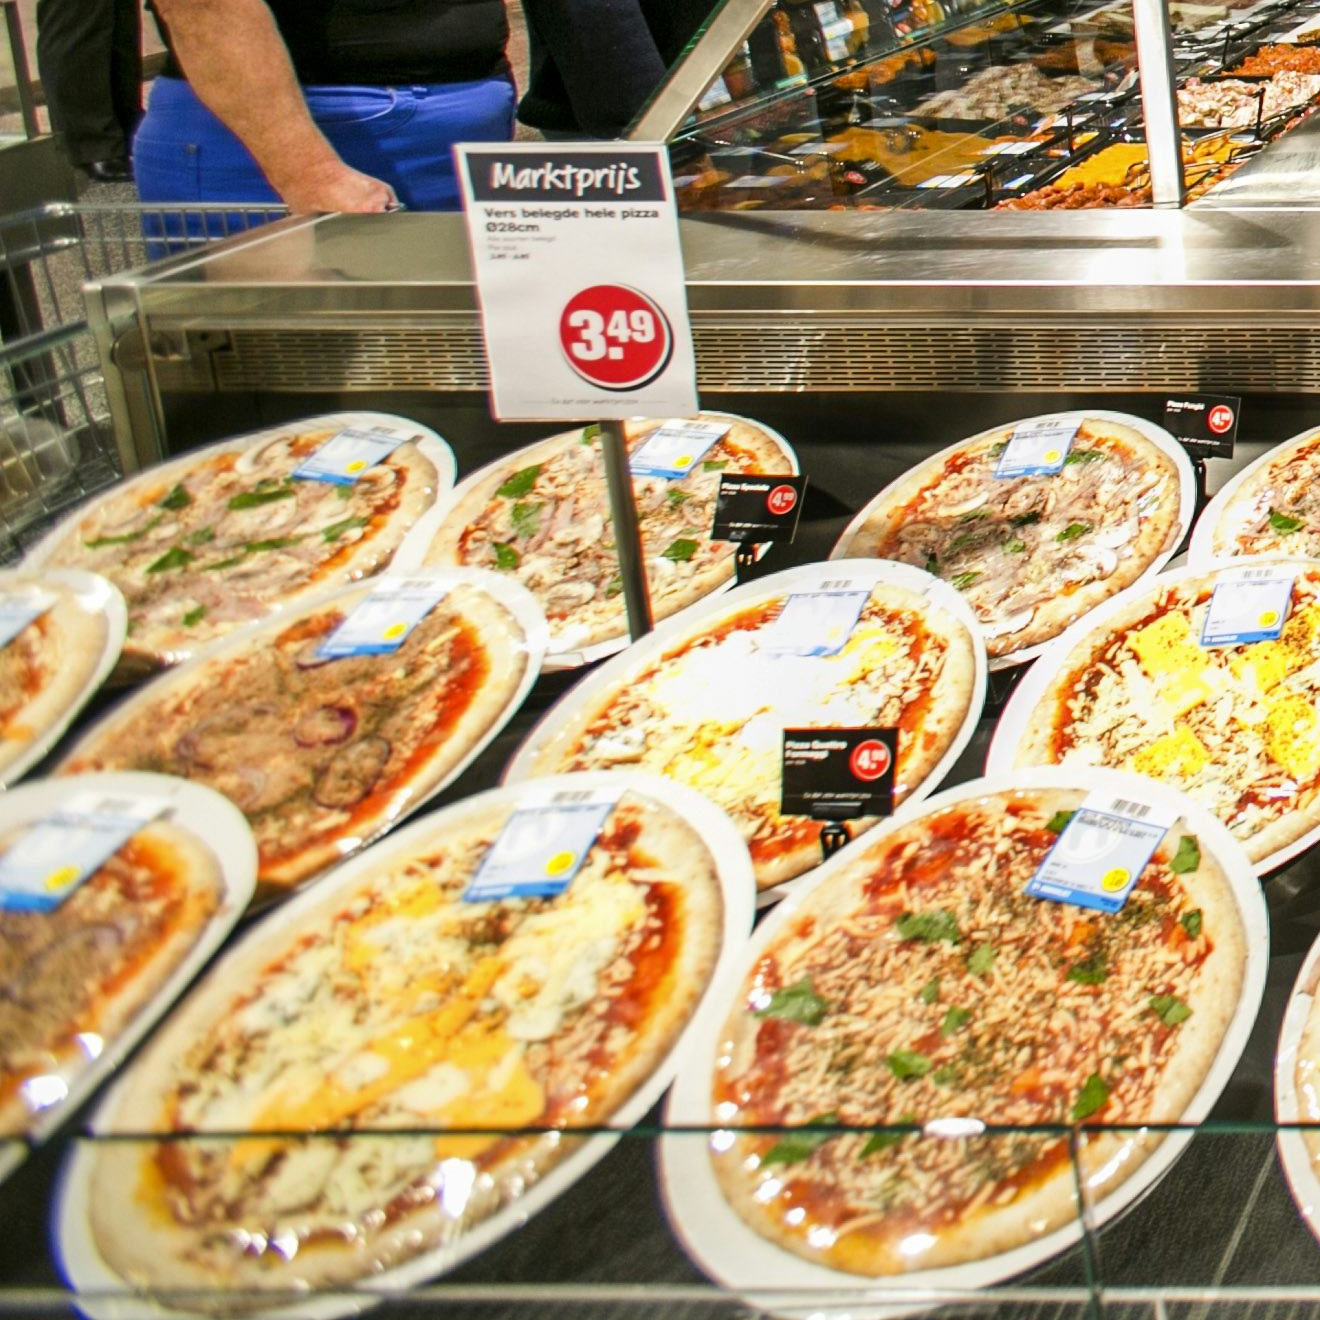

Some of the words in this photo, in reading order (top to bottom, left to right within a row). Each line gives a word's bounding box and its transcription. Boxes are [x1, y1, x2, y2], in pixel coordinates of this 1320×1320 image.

[492, 161, 641, 197] Marktprijs
[484, 208, 517, 218] Vers
[521, 207, 579, 221] belegde
[585, 208, 616, 218] hele
[621, 208, 659, 221] pizza
[569, 309, 656, 361] 3.49
